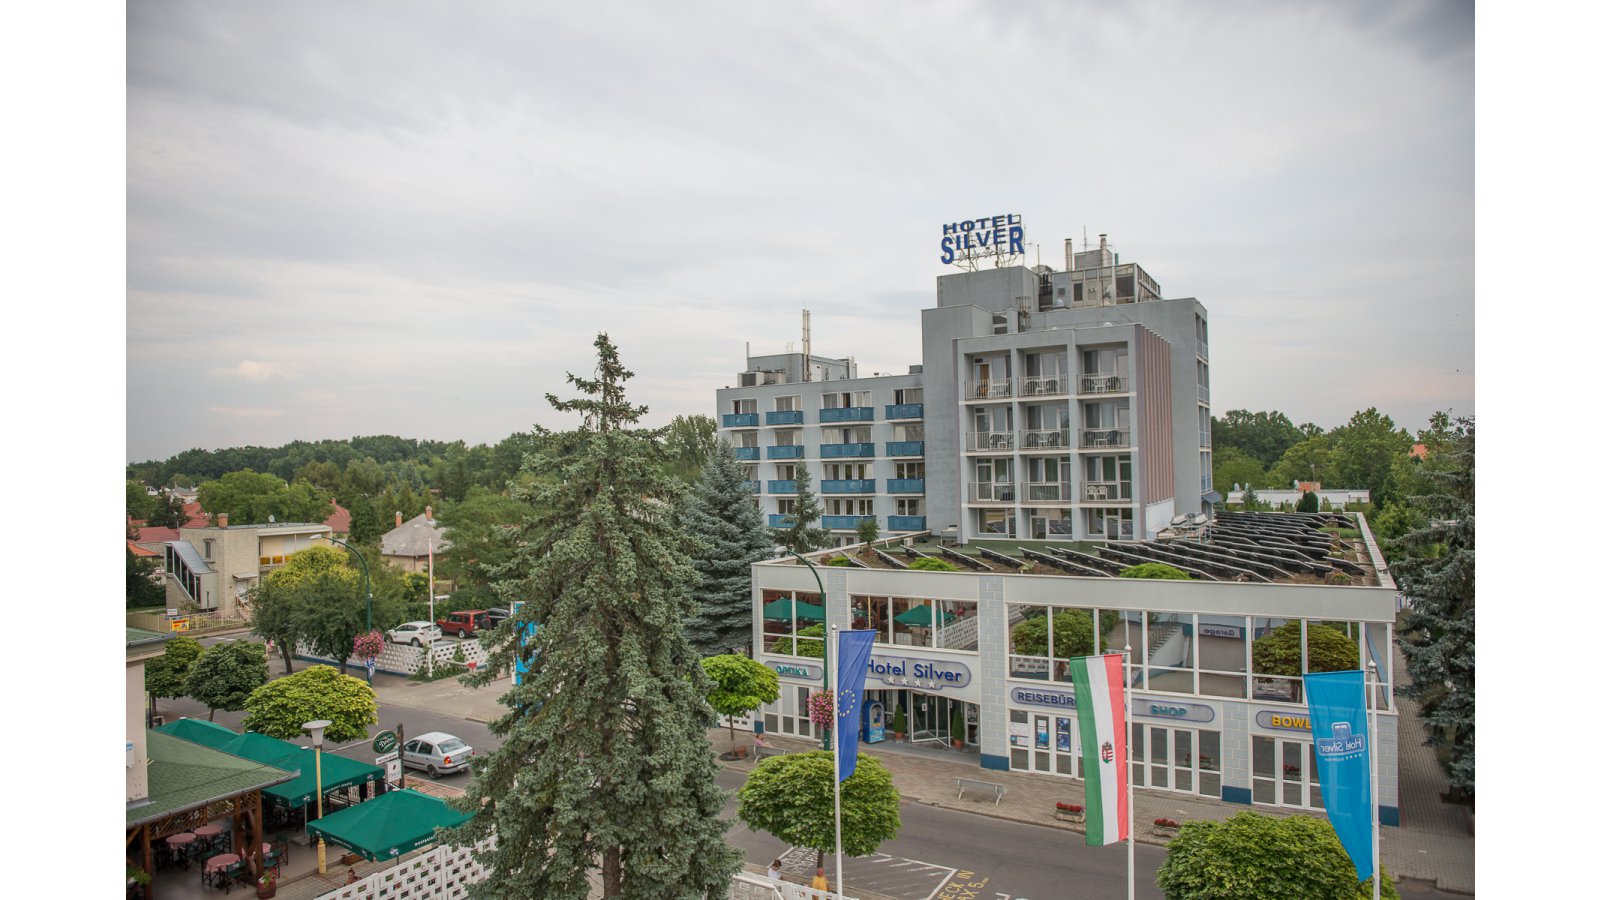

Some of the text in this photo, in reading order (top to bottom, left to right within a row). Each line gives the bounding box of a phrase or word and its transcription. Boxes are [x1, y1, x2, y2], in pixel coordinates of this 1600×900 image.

[942, 213, 1020, 236] HOTEL
[940, 226, 1025, 264] SILVER
[775, 665, 809, 677] OPTIKA
[867, 659, 962, 681] Hotel Silver
[1017, 692, 1076, 706] REISEBÜR
[1151, 704, 1188, 717] SHOP
